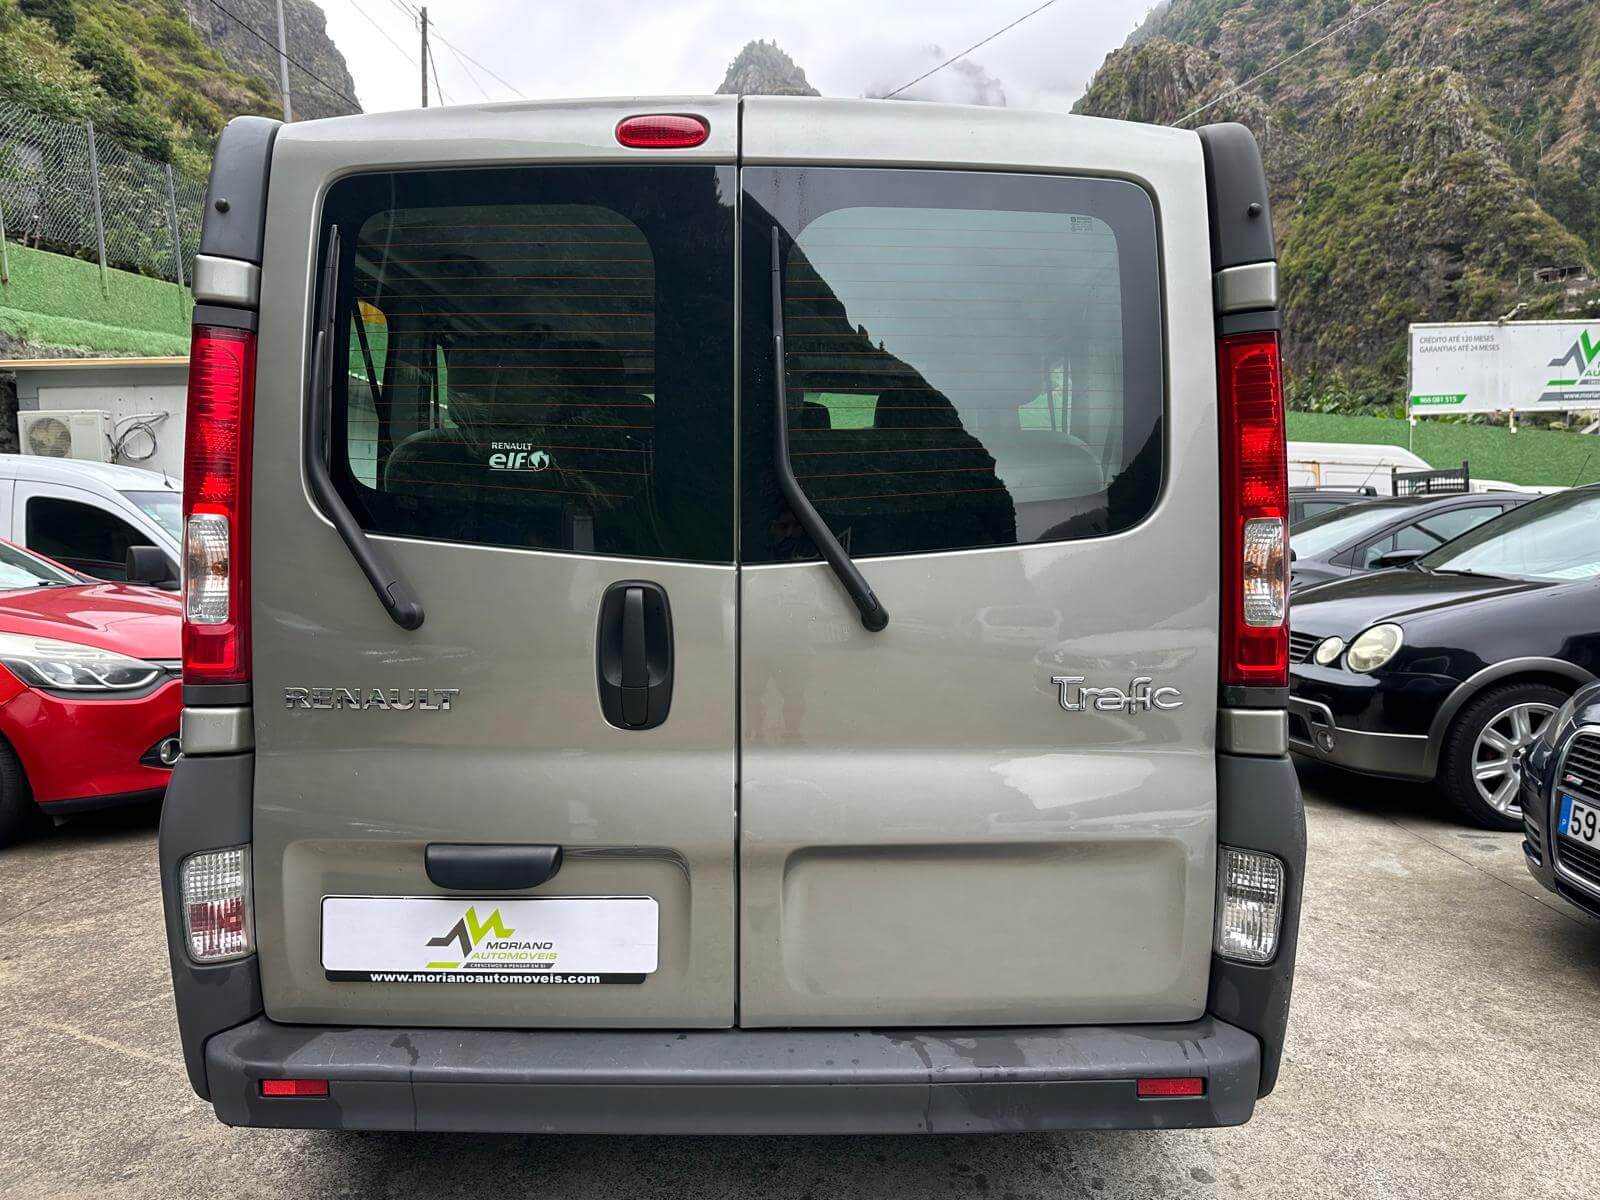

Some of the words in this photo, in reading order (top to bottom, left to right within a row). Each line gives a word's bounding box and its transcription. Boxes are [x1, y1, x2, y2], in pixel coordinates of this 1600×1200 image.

[1419, 335, 1447, 344] CRÉDITO
[1448, 334, 1460, 343] ATÉ
[1461, 335, 1472, 343] 120
[1473, 335, 1494, 343] MESES
[1419, 345, 1456, 353] GARANTIAS
[1457, 343, 1469, 352] ATÉ
[1469, 344, 1478, 352] 24
[1478, 344, 1500, 352] MESES
[491, 441, 532, 451] RENAULT
[488, 452, 527, 469] elf
[284, 687, 460, 710] RENAULT
[1051, 676, 1184, 715] Trafic
[486, 941, 553, 950] MORIANO
[370, 972, 600, 984] www.morianoautomoveis.com
